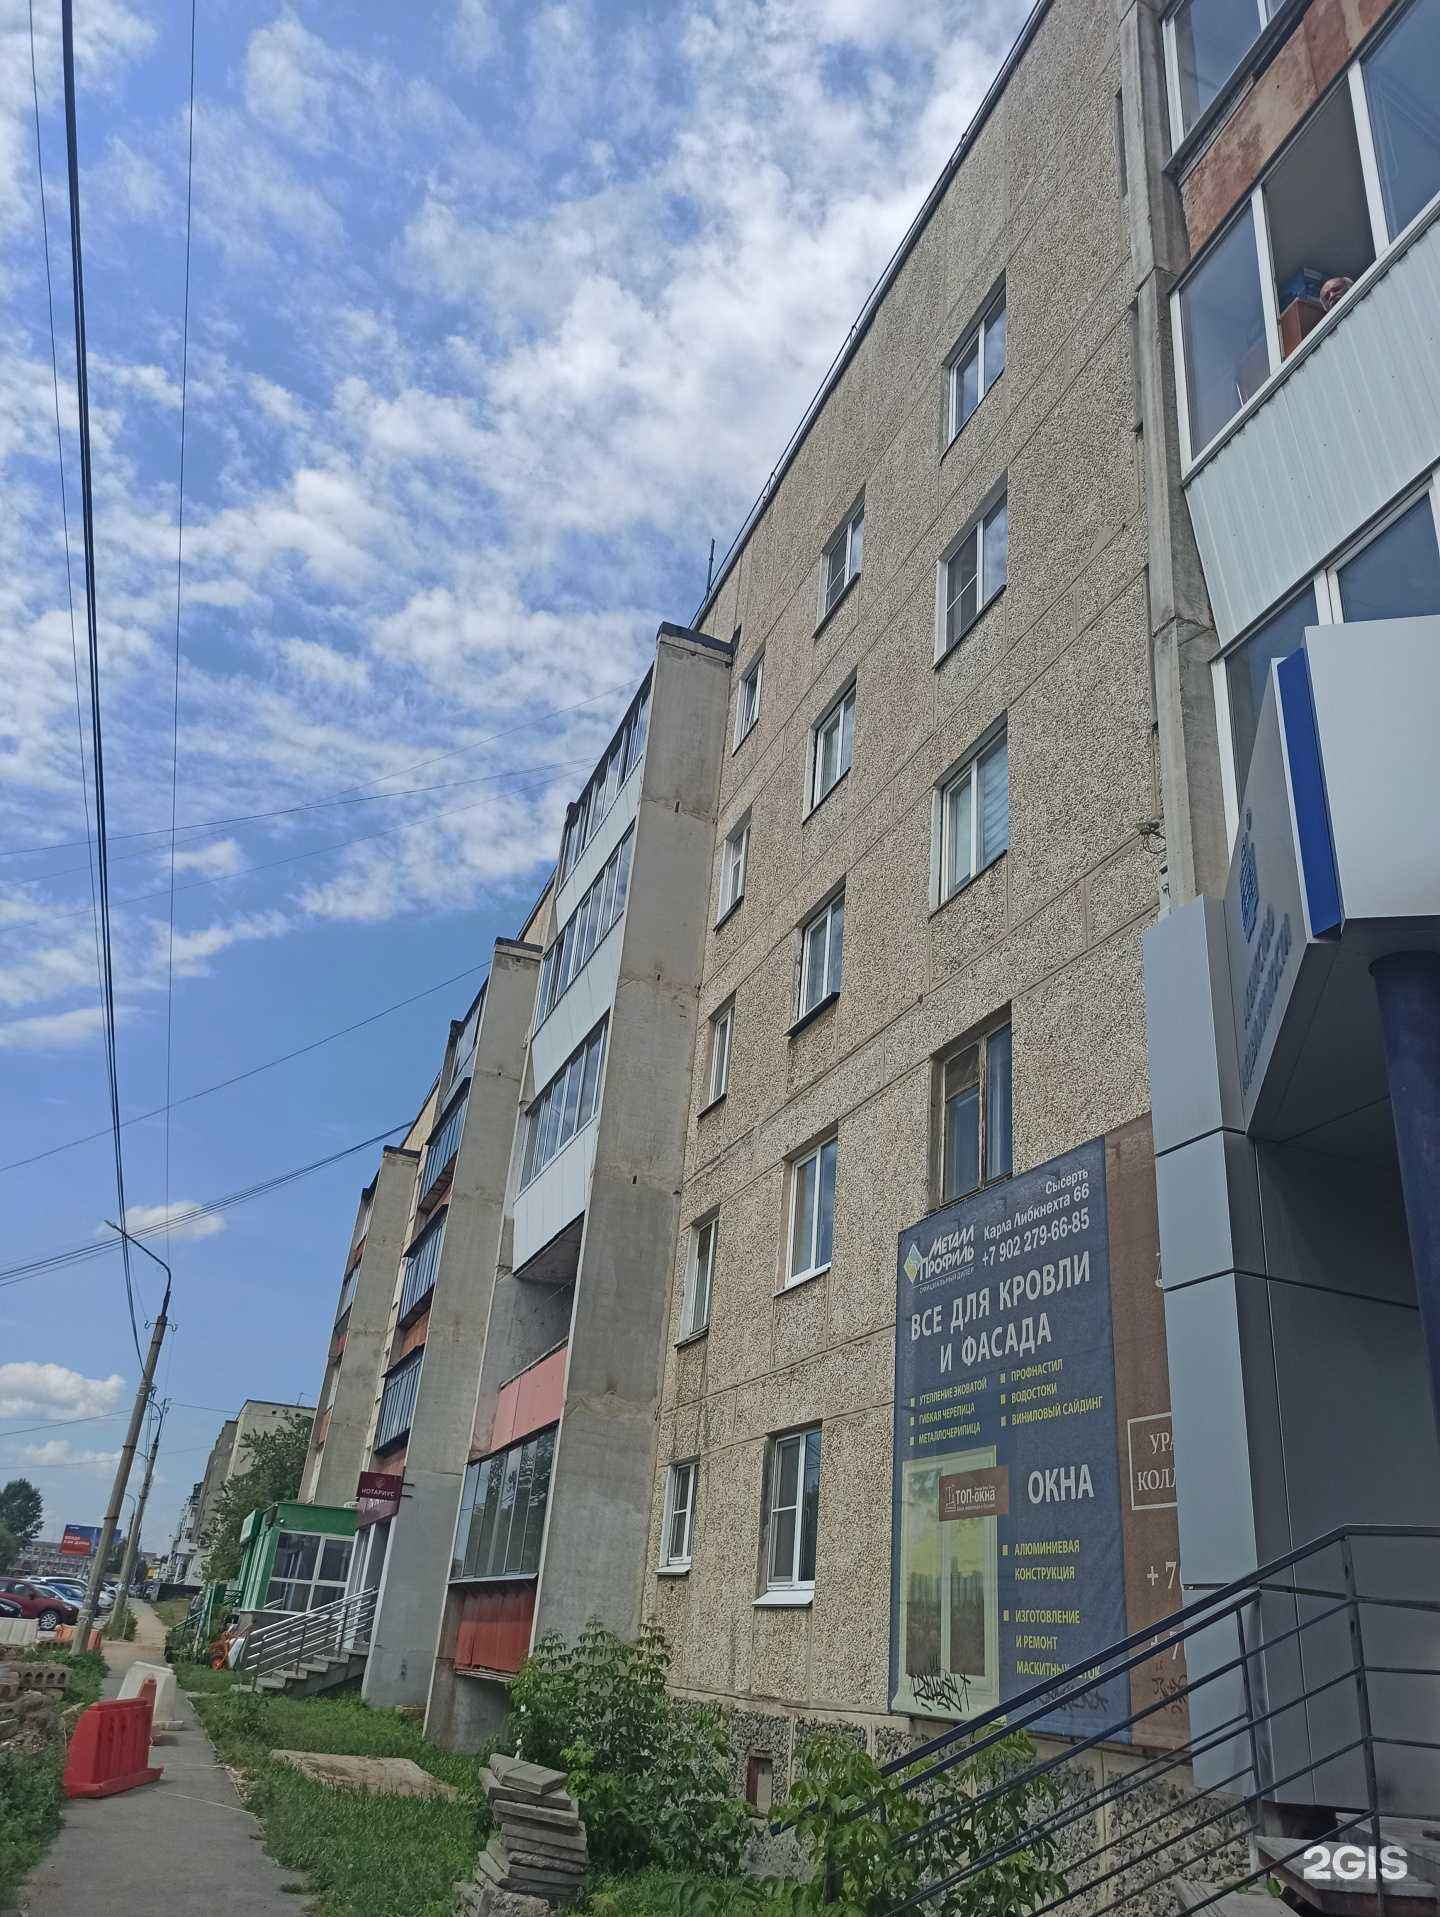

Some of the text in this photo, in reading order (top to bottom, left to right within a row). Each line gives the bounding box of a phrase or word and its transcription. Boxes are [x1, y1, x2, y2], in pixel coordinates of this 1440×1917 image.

[1045, 1168, 1088, 1194] Сысерть
[984, 1182, 1090, 1241] Карла Либкнехта 66
[982, 1207, 1090, 1266] +7 902 279-66-85
[911, 1251, 1090, 1341] ВСЕ ДЛЯ КРОВЛИ
[940, 1312, 1052, 1373] И ФАСАДА
[1011, 1358, 1063, 1381] ПРОФНАСТИЛ
[920, 1385, 953, 1406] УТЕПЛЕНИЕ
[1011, 1383, 1057, 1403] ВОДОСТОКИ
[919, 1401, 975, 1424] ГИБКАЯ ЧЕРЕПИЦА
[1011, 1395, 1103, 1425] ВИНИЛОВЫЙ САЙДИНГ
[1027, 1464, 1094, 1504] ОКНА
[1014, 1540, 1080, 1556] АЛЮМИНИЕВАЯ
[1015, 1566, 1075, 1582] КОНСТРУКЦИЯ
[1015, 1610, 1080, 1624] ИЗГОТОВЛЕНИЕ
[1023, 1635, 1058, 1650] РЕМОНТ
